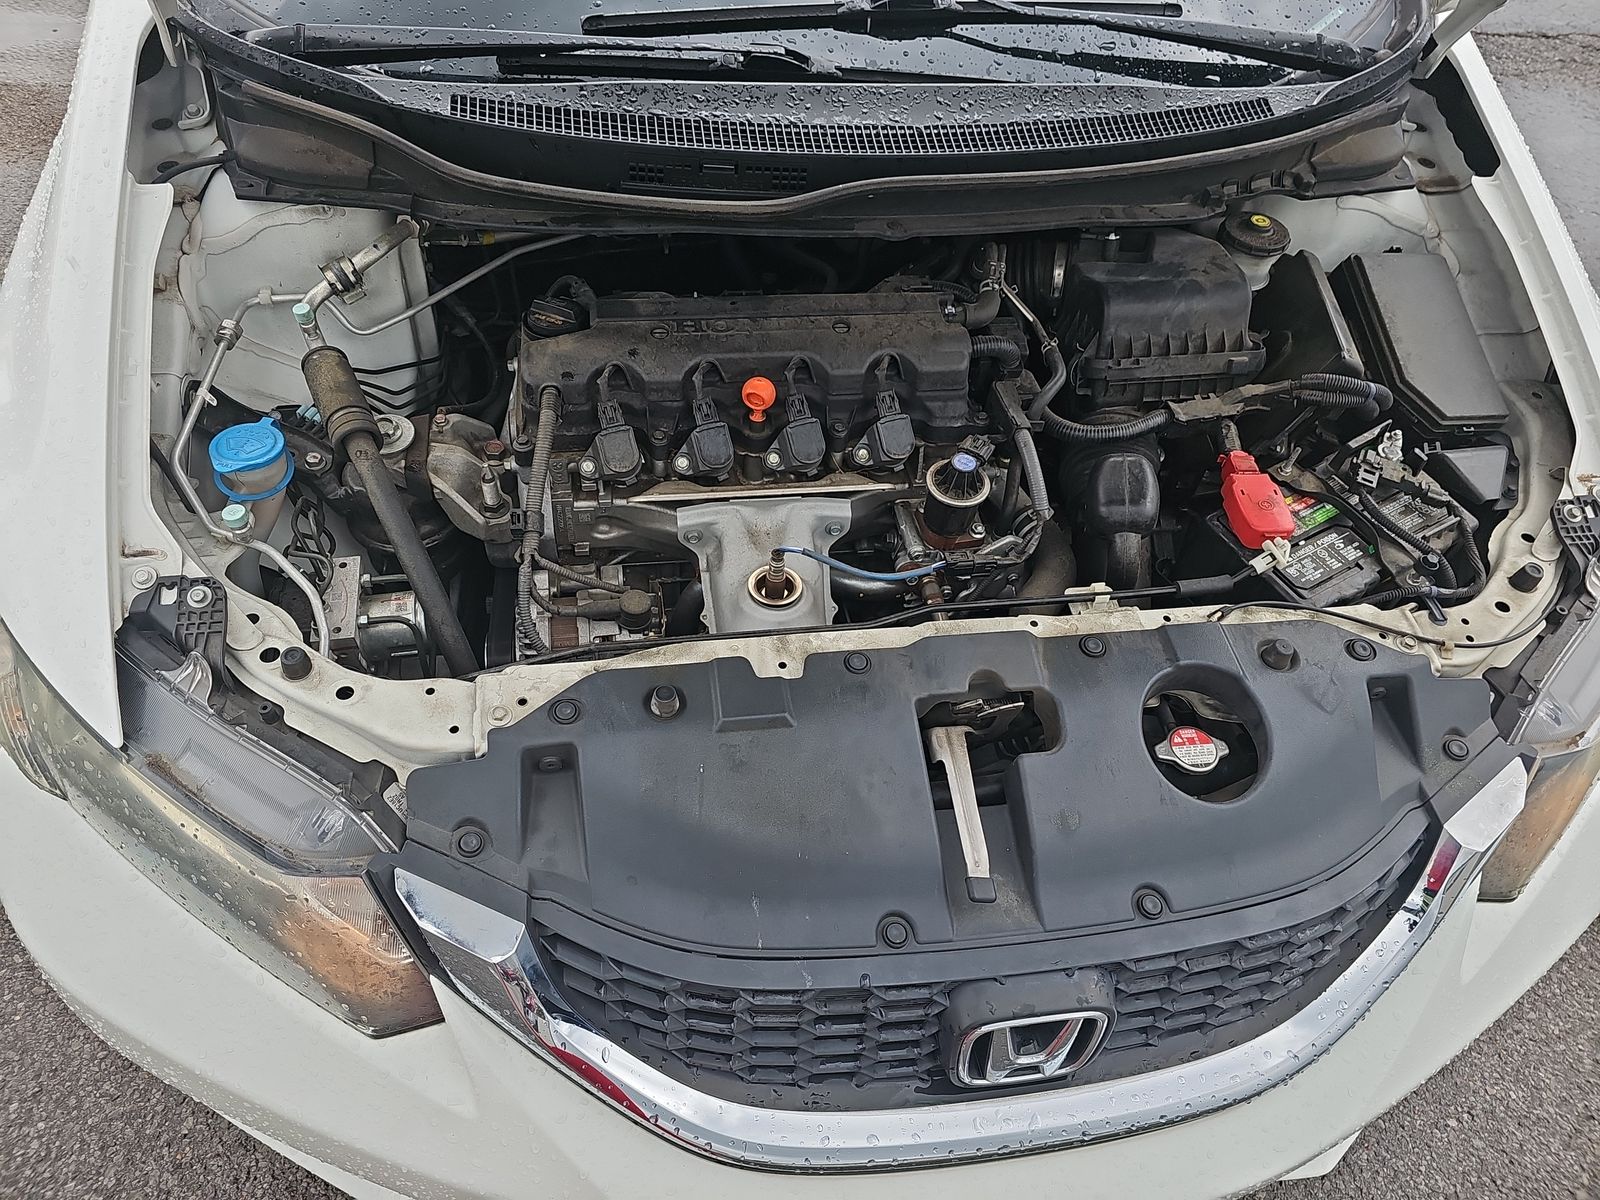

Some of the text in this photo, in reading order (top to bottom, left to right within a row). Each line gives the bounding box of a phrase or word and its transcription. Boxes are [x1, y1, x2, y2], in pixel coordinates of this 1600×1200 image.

[216, 461, 234, 469] PULL
[1292, 544, 1315, 559] DANGER
[1316, 532, 1339, 545] POISON
